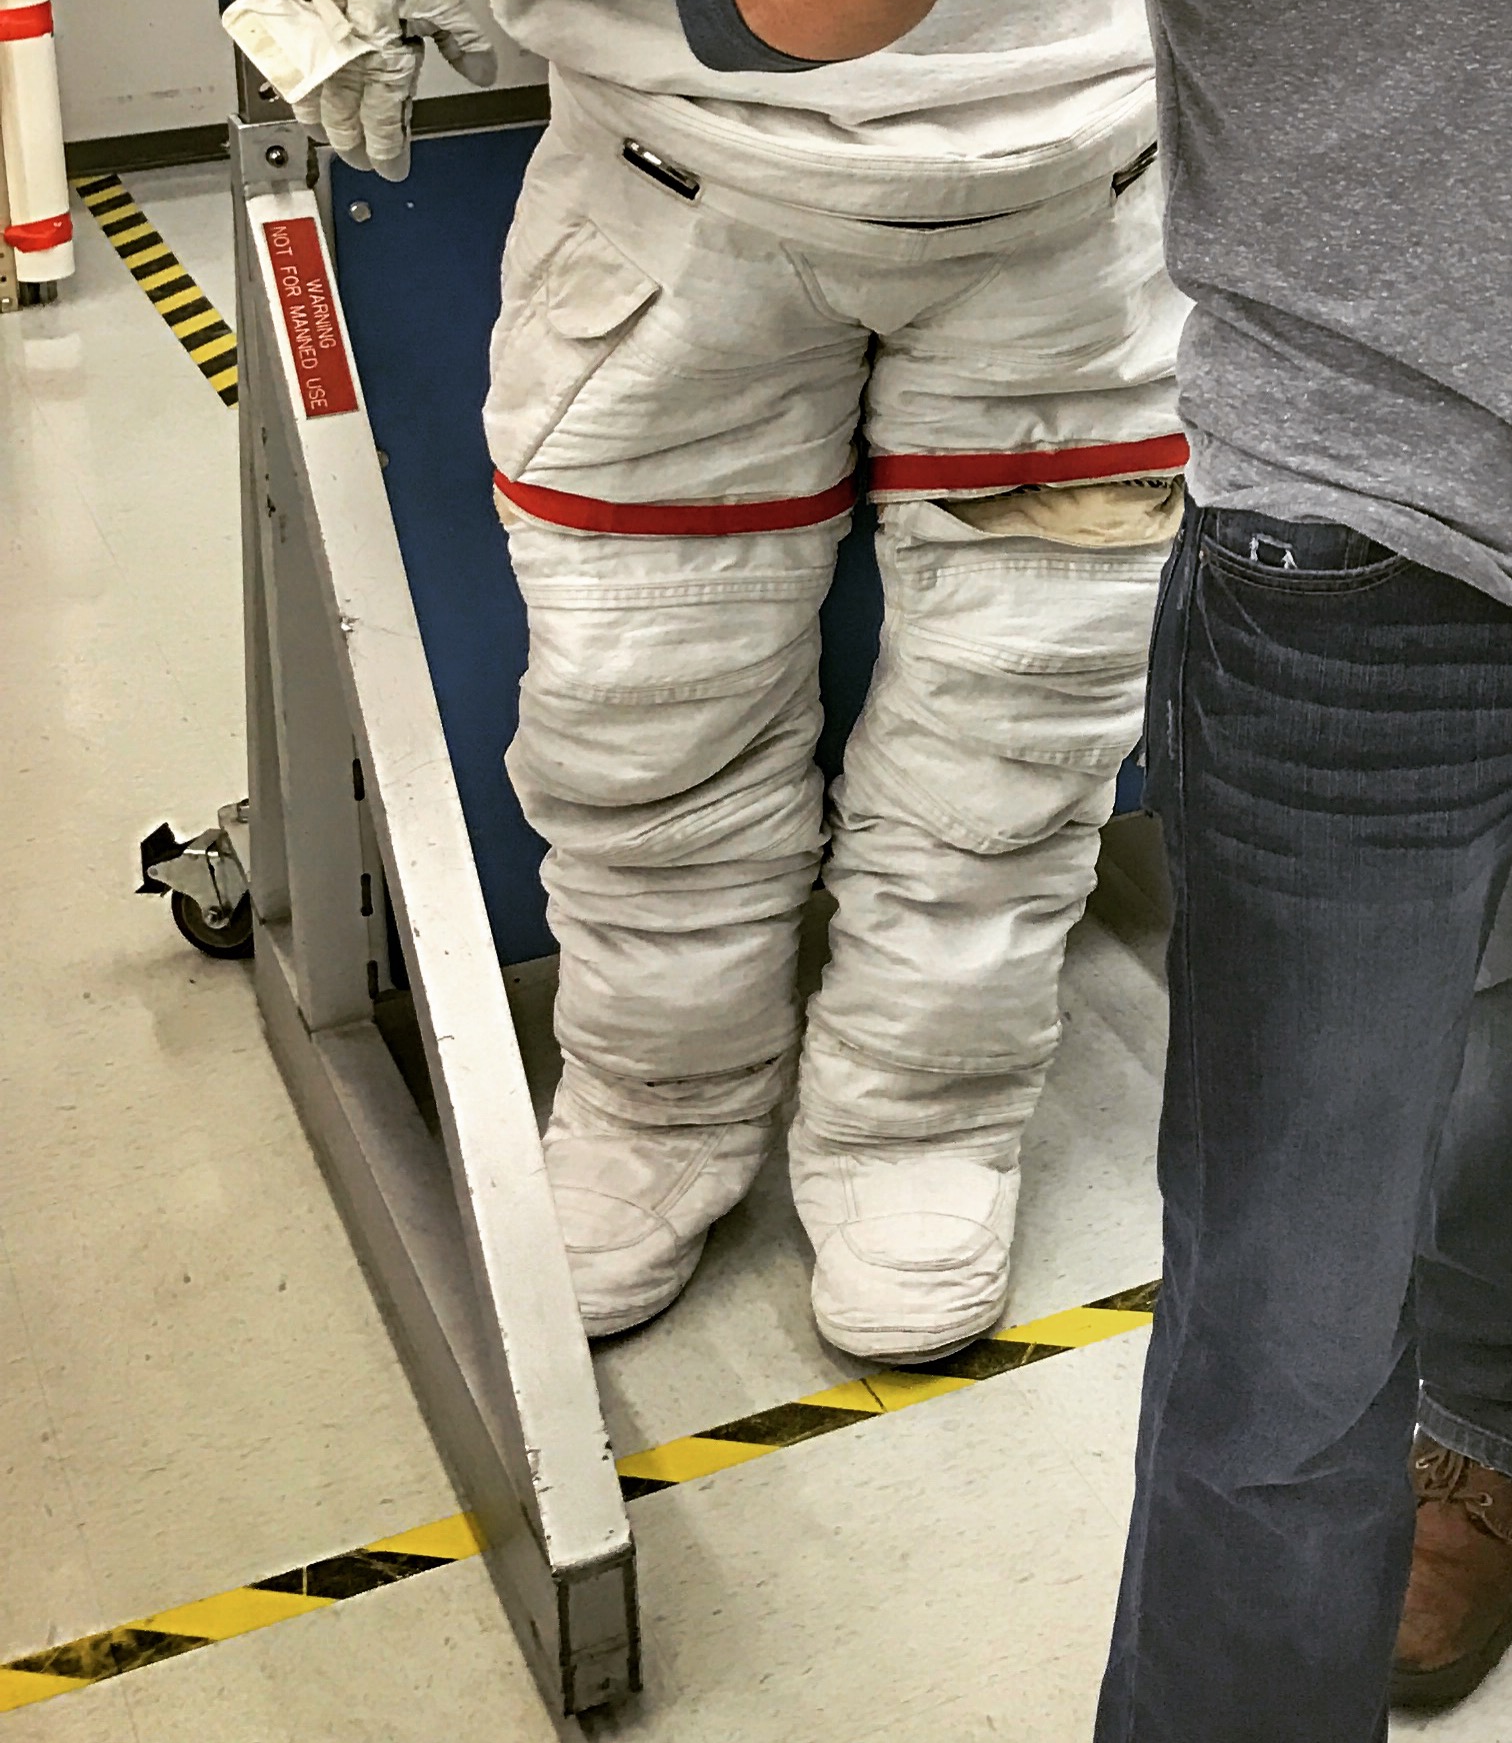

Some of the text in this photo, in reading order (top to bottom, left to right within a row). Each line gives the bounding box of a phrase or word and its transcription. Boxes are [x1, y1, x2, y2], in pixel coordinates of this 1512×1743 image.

[271, 225, 328, 410] NOT FOR MANNED USE
[306, 278, 337, 349] WARNING
